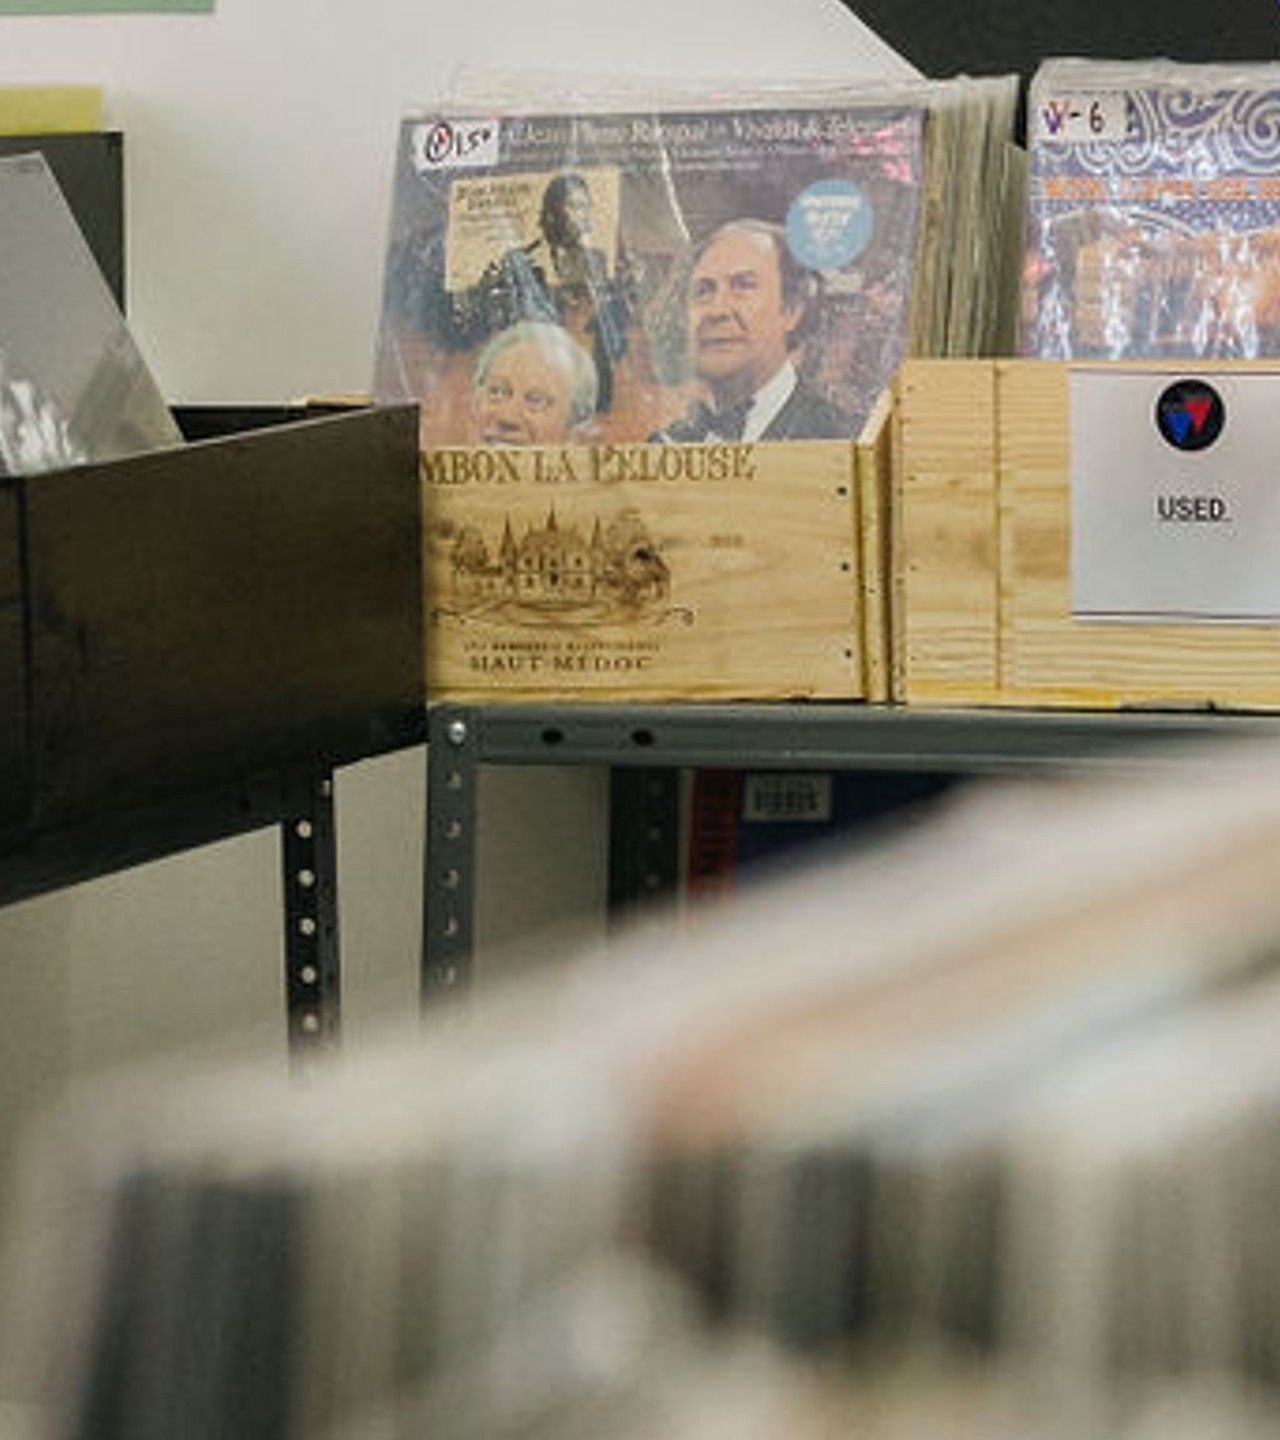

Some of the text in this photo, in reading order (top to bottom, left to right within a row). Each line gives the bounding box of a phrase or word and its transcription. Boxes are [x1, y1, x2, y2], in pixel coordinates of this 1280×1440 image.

[534, 450, 577, 484] LA
[592, 443, 756, 483] PELOUSE
[1156, 495, 1227, 522] USED
